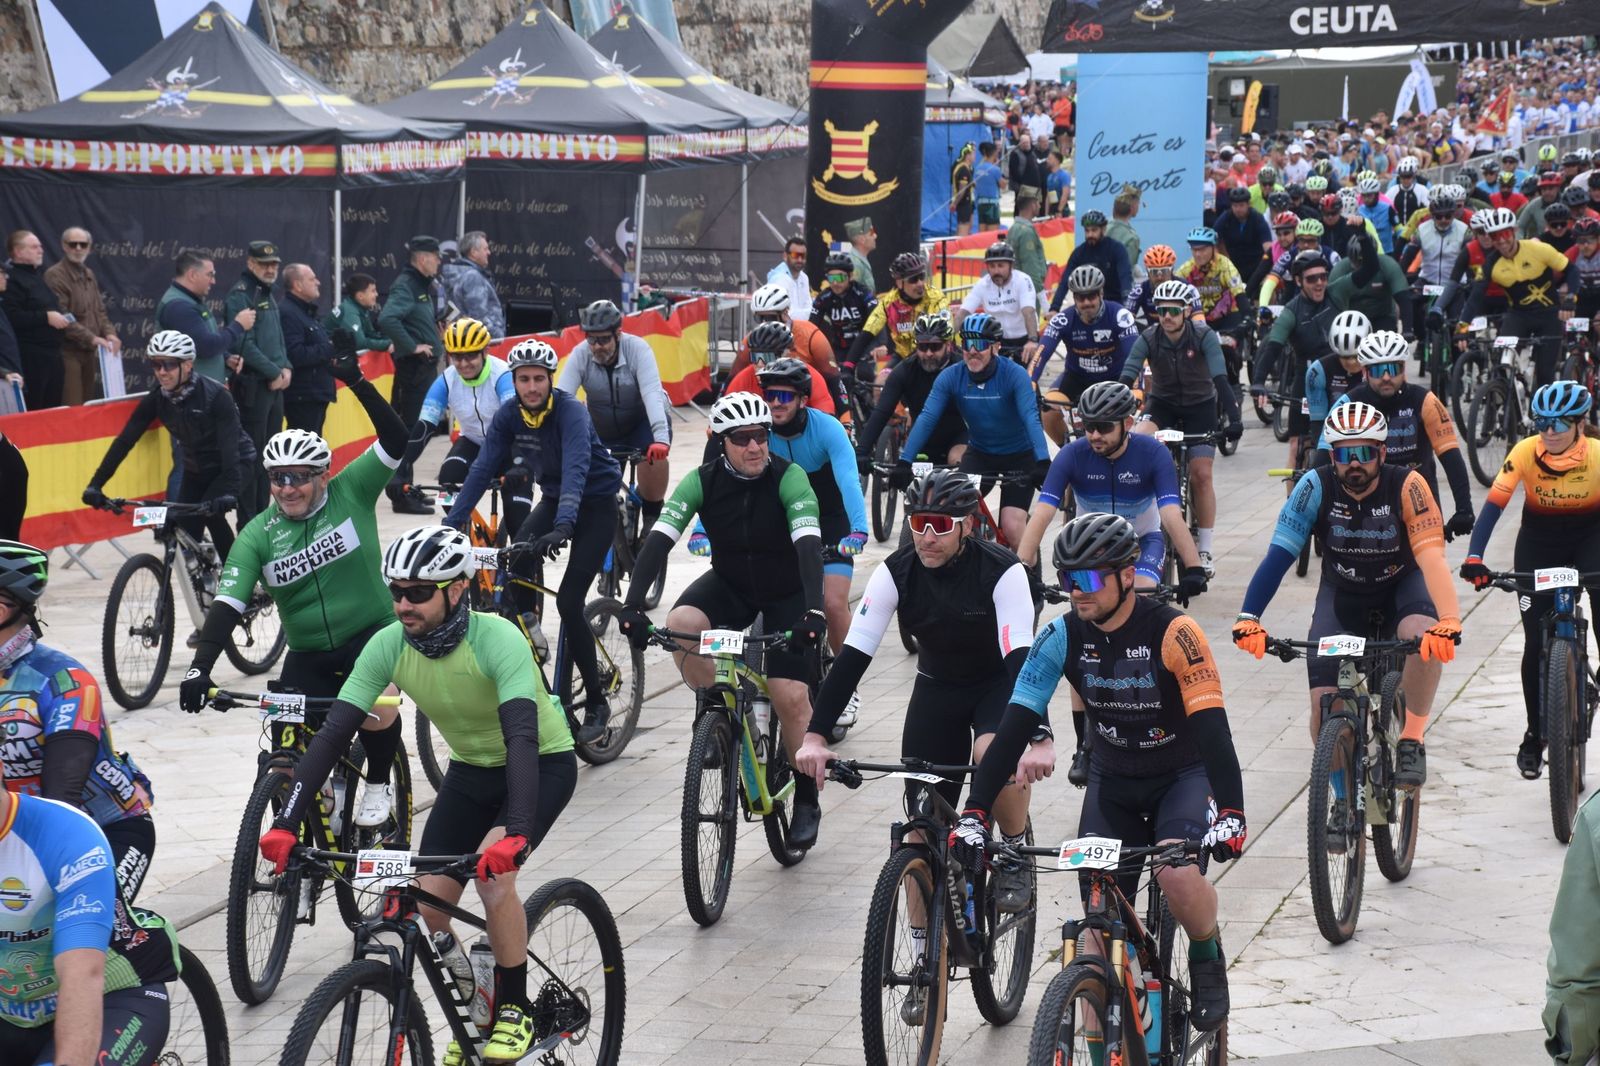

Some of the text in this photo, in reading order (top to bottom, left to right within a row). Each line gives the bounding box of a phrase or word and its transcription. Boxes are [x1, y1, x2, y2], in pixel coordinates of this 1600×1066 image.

[1289, 5, 1397, 35] CEUTA
[1088, 131, 1186, 159] Ceuta es
[1, 136, 304, 175] LUB DEPORTIVO
[831, 307, 861, 321] UAE
[274, 531, 344, 573] ANDALUCIA
[427, 544, 455, 574] SCOTT
[276, 541, 348, 584] NATURE
[1552, 573, 1574, 583] 598
[719, 637, 738, 648] 411
[1336, 641, 1360, 650] 549
[1126, 645, 1152, 661] telfy
[1084, 672, 1156, 691] Bacanal
[95, 760, 135, 800] CEUTA
[1083, 846, 1115, 860] 497
[376, 861, 403, 877] 588
